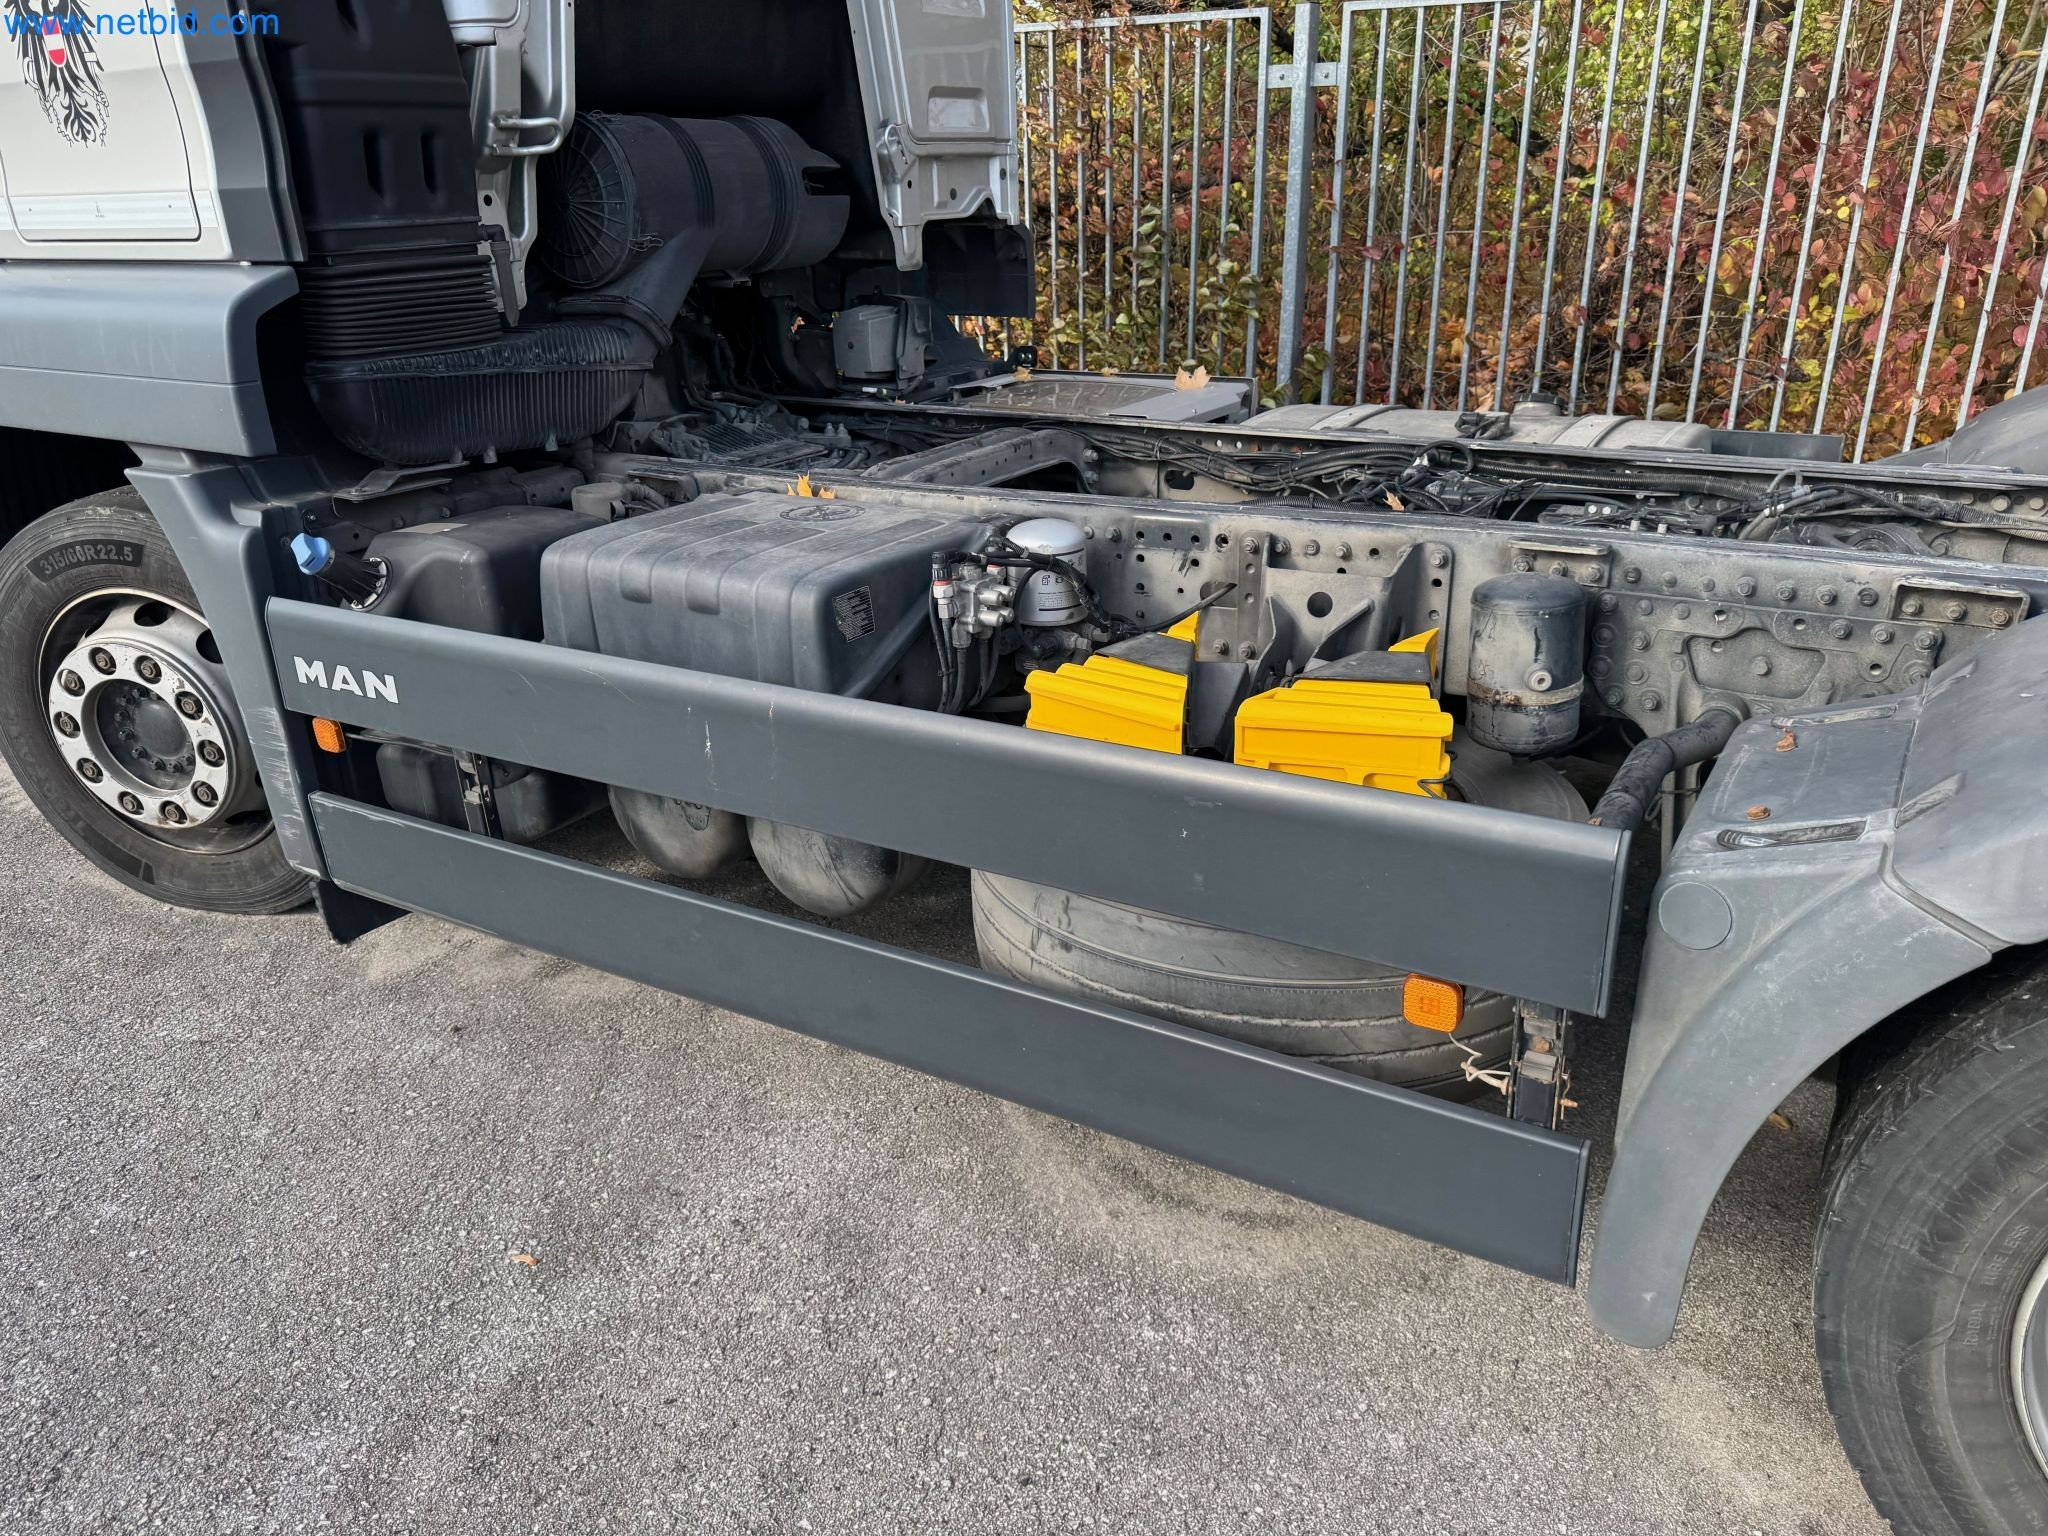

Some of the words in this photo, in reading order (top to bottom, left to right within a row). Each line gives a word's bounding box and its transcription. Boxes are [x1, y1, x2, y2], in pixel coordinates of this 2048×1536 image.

[39, 544, 134, 575] 315/60R22.5
[293, 655, 399, 704] MAN
[1962, 1301, 1987, 1346] RADIAL
